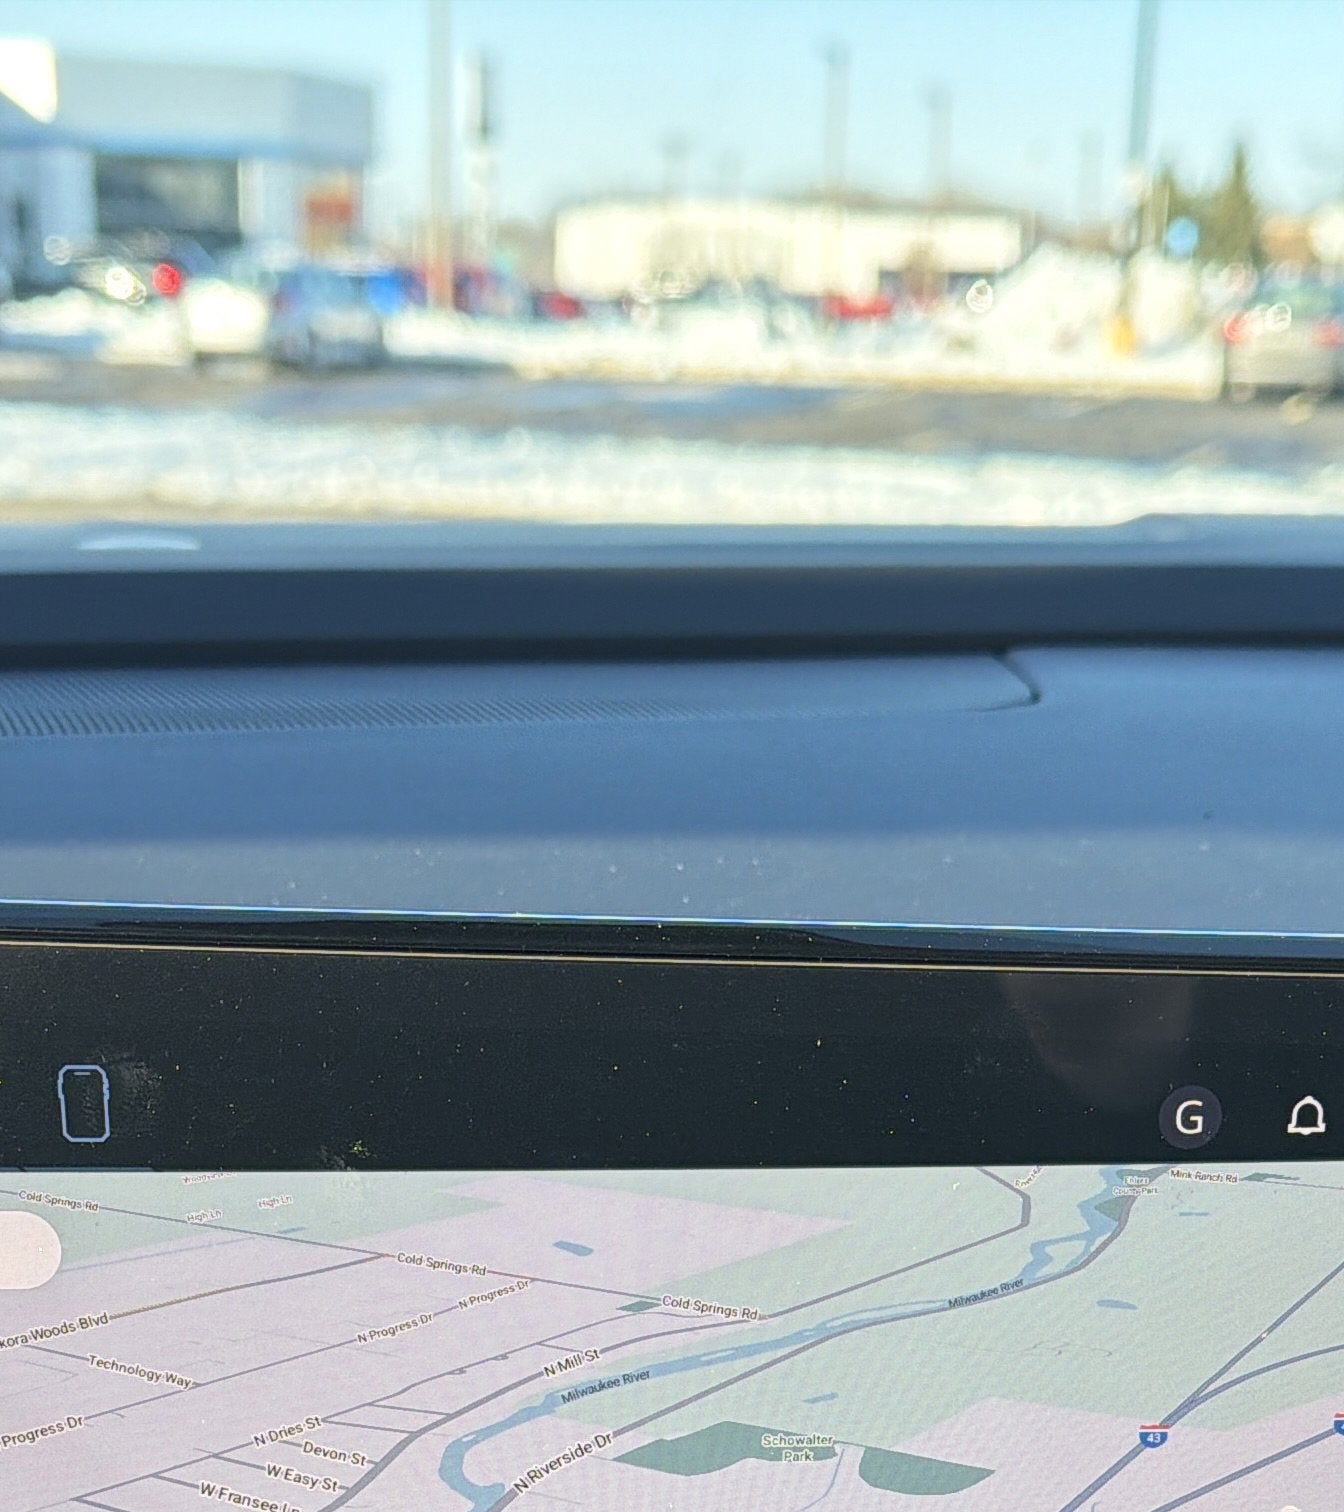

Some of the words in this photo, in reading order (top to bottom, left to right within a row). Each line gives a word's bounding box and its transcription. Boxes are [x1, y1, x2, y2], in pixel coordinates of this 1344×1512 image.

[1176, 1100, 1203, 1134] G
[19, 1191, 42, 1202] Cold
[43, 1195, 83, 1211] Springs
[85, 1201, 98, 1211] Rd
[397, 1253, 422, 1264] Cold
[426, 1258, 467, 1275] Springs
[472, 1265, 486, 1275] Rd
[458, 1300, 467, 1309] N
[469, 1286, 515, 1306] Progress
[517, 1280, 529, 1290] Dr
[1000, 1278, 1024, 1293] River
[662, 1296, 690, 1308] Cold
[693, 1300, 737, 1319] Springs
[740, 1308, 757, 1319] Rd
[31, 1320, 76, 1341] Woods
[79, 1313, 108, 1330] Blvd
[357, 1333, 366, 1343] N
[367, 1319, 417, 1341] Progress
[420, 1314, 433, 1325] Dr
[89, 1355, 161, 1384] Technology
[165, 1372, 192, 1388] Way
[544, 1366, 555, 1377] N
[558, 1355, 582, 1371] Mill
[585, 1349, 599, 1361] St
[561, 1376, 620, 1403] Milwaukee
[623, 1370, 650, 1384] River
[0, 1422, 64, 1447] Progress
[68, 1416, 84, 1427] Dr
[254, 1435, 266, 1447] N
[268, 1424, 303, 1443] Dries
[305, 1417, 321, 1429] St
[762, 1435, 833, 1446] Schowalter
[1146, 1433, 1160, 1443] 43
[303, 1442, 347, 1461] Devon
[351, 1454, 366, 1466] St
[515, 1479, 528, 1493] N
[529, 1444, 592, 1484] Riverside
[595, 1432, 613, 1447] Dr
[784, 1451, 812, 1462] Park
[201, 1482, 216, 1496] W
[267, 1464, 282, 1478] W
[284, 1468, 317, 1488] Easy
[321, 1478, 337, 1492] St
